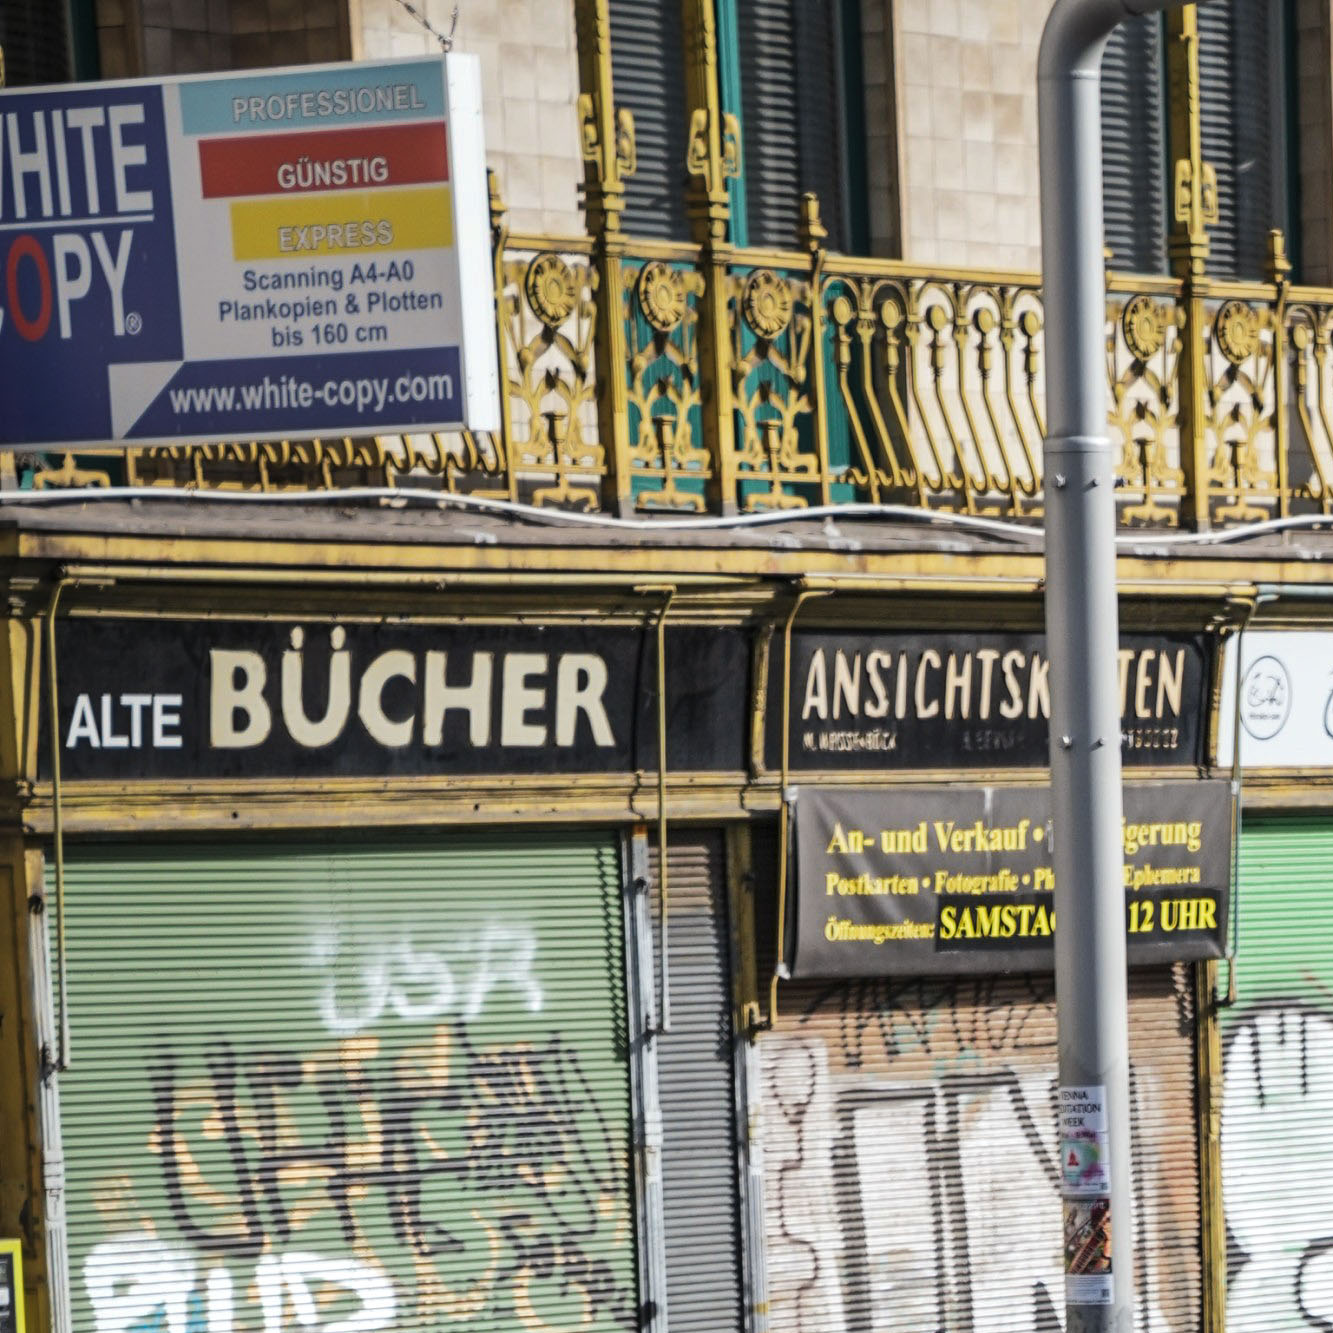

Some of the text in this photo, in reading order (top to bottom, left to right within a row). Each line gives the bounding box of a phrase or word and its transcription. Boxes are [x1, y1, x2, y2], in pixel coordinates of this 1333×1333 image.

[232, 85, 426, 121] PROFESSIONEL
[0, 104, 153, 218] HITE
[277, 157, 389, 189] GÜNSTIG
[277, 220, 394, 253] EXPRESS
[0, 229, 134, 341] OPY
[243, 260, 415, 292] Scanning A4-A0
[219, 290, 443, 322] Plankopien & Plotten
[271, 323, 388, 348] bis 160 cm
[170, 373, 453, 414] www.white-copy.com
[66, 625, 616, 749] ALTE BÜCHER
[801, 648, 1185, 719] ANSICHTSKTEN
[826, 821, 875, 854] An-
[880, 821, 928, 854] und
[933, 818, 1031, 853] Verkauf
[825, 871, 919, 896] Postkarten
[933, 867, 1020, 895] Fotografie
[939, 903, 1057, 940] SAMSTA
[1127, 900, 1155, 933] 12
[1160, 898, 1217, 932] UHR
